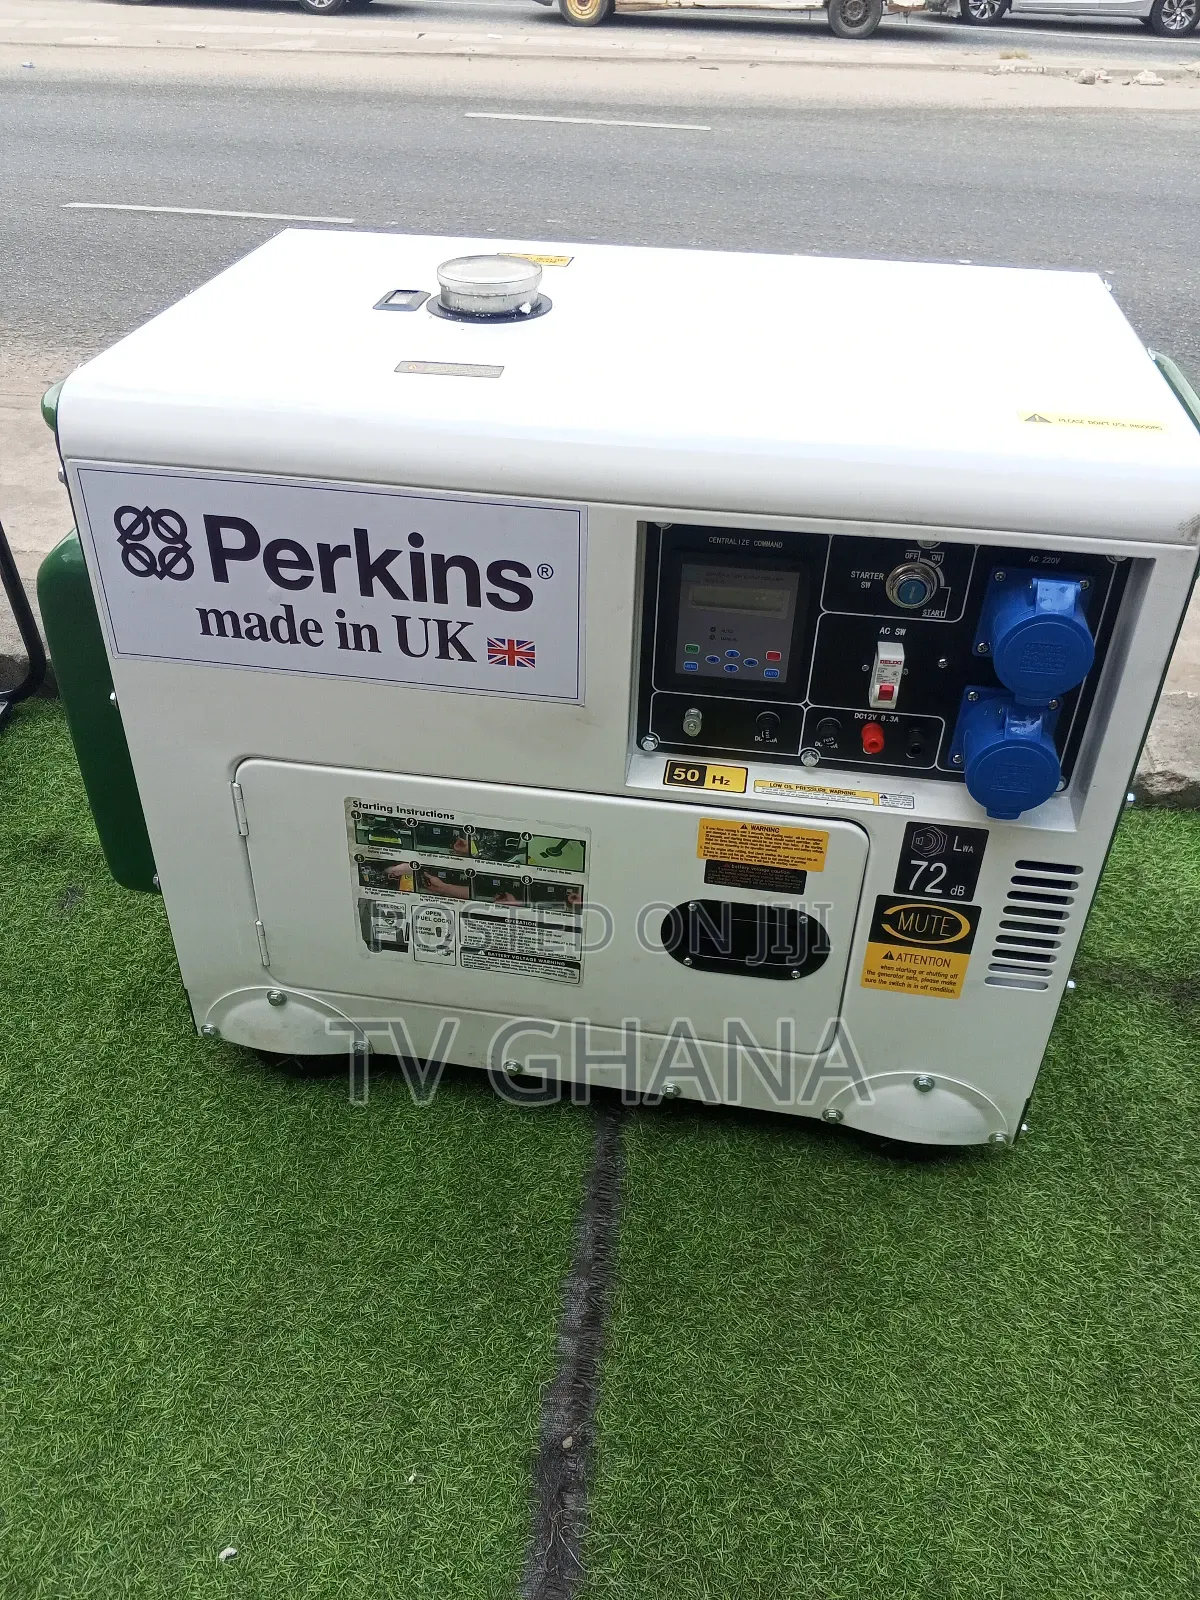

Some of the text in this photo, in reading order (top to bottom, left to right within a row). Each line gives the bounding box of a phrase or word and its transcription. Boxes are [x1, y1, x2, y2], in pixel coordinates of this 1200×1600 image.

[708, 536, 784, 549] CENTRALIZE COMMAND
[904, 552, 919, 560] OFF
[931, 554, 941, 562] ON
[1028, 555, 1061, 565] AC 220V
[850, 570, 885, 580] STARTER
[860, 581, 872, 589] SW
[922, 608, 944, 617] START
[196, 604, 477, 664] made in UK
[879, 626, 907, 636] AC SW
[854, 712, 899, 723] DC12V 8.3A
[672, 767, 730, 786] 50 Hz
[353, 800, 455, 820] Starting Instructions
[750, 825, 780, 833] WARNING
[908, 859, 966, 897] 72 dB
[504, 918, 537, 927] OPERATION
[897, 911, 956, 938] MUTE
[488, 951, 565, 966] BATTERY VOLTAGE WARNING
[896, 953, 951, 968] ATTENTION
[877, 971, 904, 979] generator
[896, 966, 917, 975] starting
[926, 970, 948, 979] shutting
[930, 986, 955, 994] condition.
